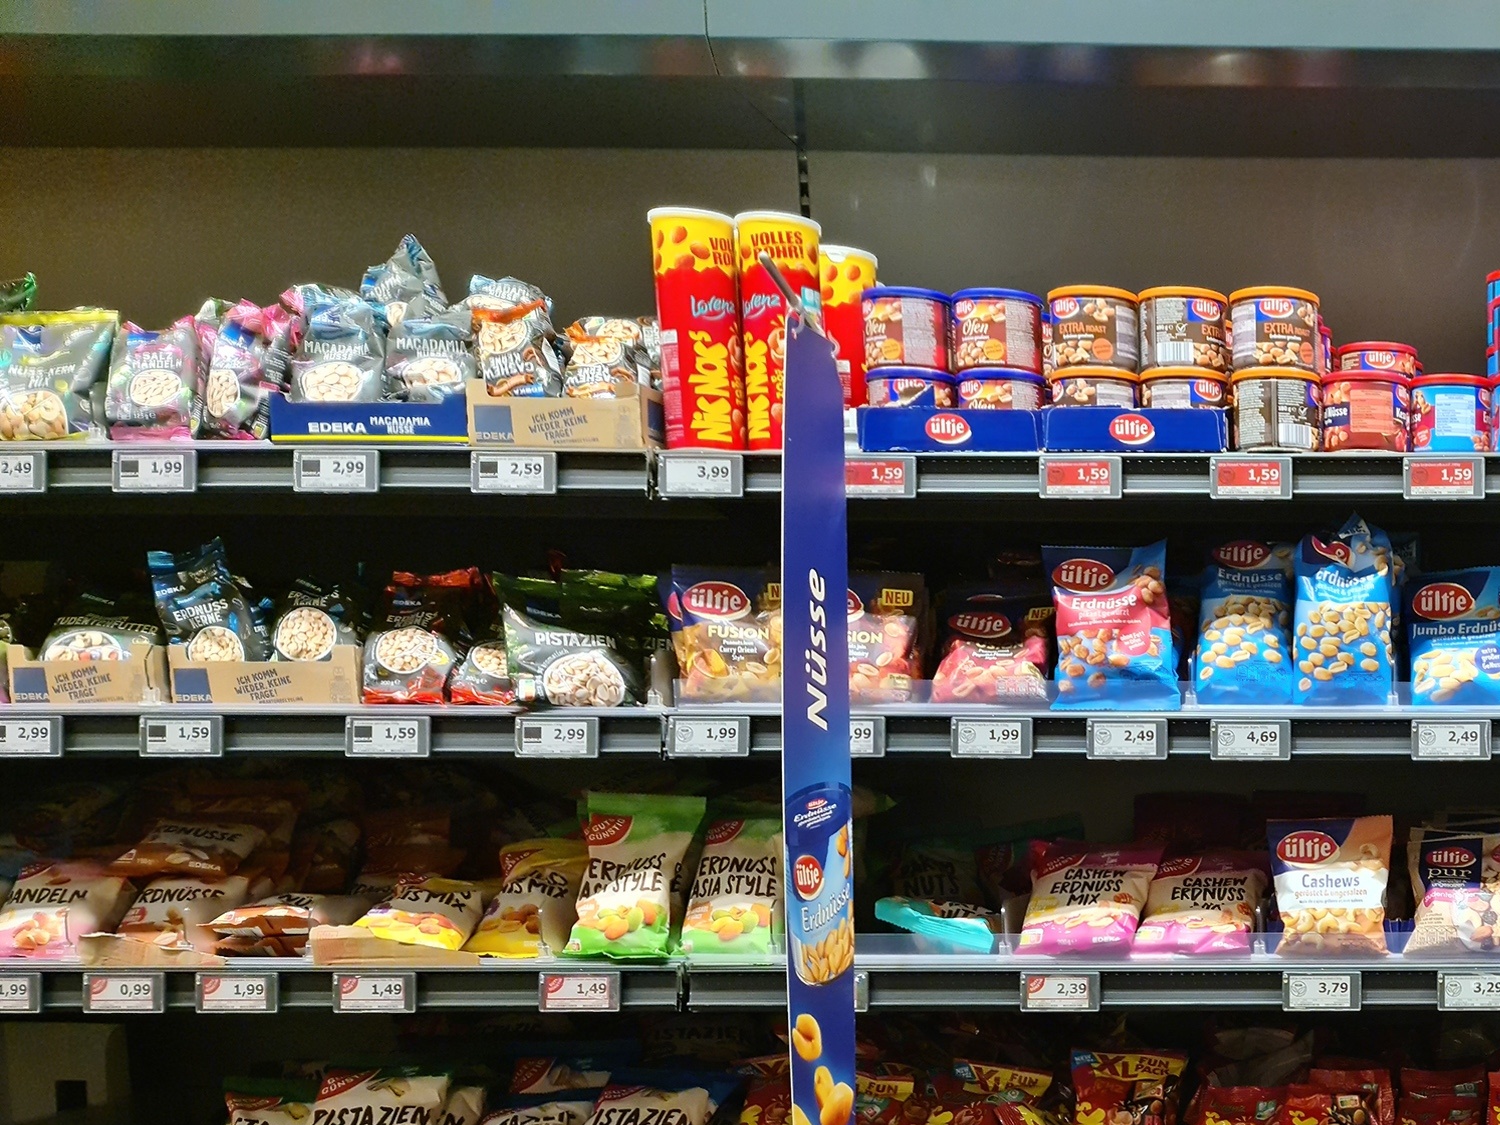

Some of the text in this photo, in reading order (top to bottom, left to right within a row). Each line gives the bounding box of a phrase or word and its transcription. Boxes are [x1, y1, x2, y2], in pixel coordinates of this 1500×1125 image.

[750, 231, 804, 247] VOLLES
[962, 319, 990, 336] Ofen
[1058, 322, 1106, 334] EXTRA ROAST
[308, 415, 430, 434] EDEKA MACADAMIA
[387, 424, 416, 435] NÜSSE
[930, 418, 965, 436] ültje
[1115, 418, 1149, 437] ültje
[151, 461, 182, 476] 1,99
[510, 462, 542, 477] 2,59
[697, 465, 729, 480] 3,99
[1077, 467, 1109, 482] 1,59
[1441, 468, 1472, 483] 1,59
[1060, 565, 1109, 586] ültje
[690, 588, 742, 613] ültje
[885, 591, 910, 606] NEU
[1071, 594, 1137, 611] Erdnüsse
[1420, 591, 1468, 613] ültje
[173, 597, 229, 623] ERDNUSS
[707, 625, 770, 640] FUSION
[956, 615, 1003, 635] ültje
[1412, 622, 1455, 639] Jumbo
[534, 631, 616, 650] PISTAZIEN
[806, 566, 830, 731] Nüsse
[178, 726, 210, 741] 1,59
[554, 728, 585, 742] 2,99
[706, 727, 737, 741] 1,99
[1124, 729, 1155, 744] 2,49
[1448, 730, 1478, 745] 2,49
[1285, 836, 1334, 860] ültje
[795, 862, 823, 886] ültje
[1302, 873, 1361, 889] Cashews
[800, 887, 850, 932] Erdnüsse
[119, 983, 150, 998] 0,99
[1057, 982, 1088, 997] 2,39
[1099, 1054, 1170, 1078] XL FUN
